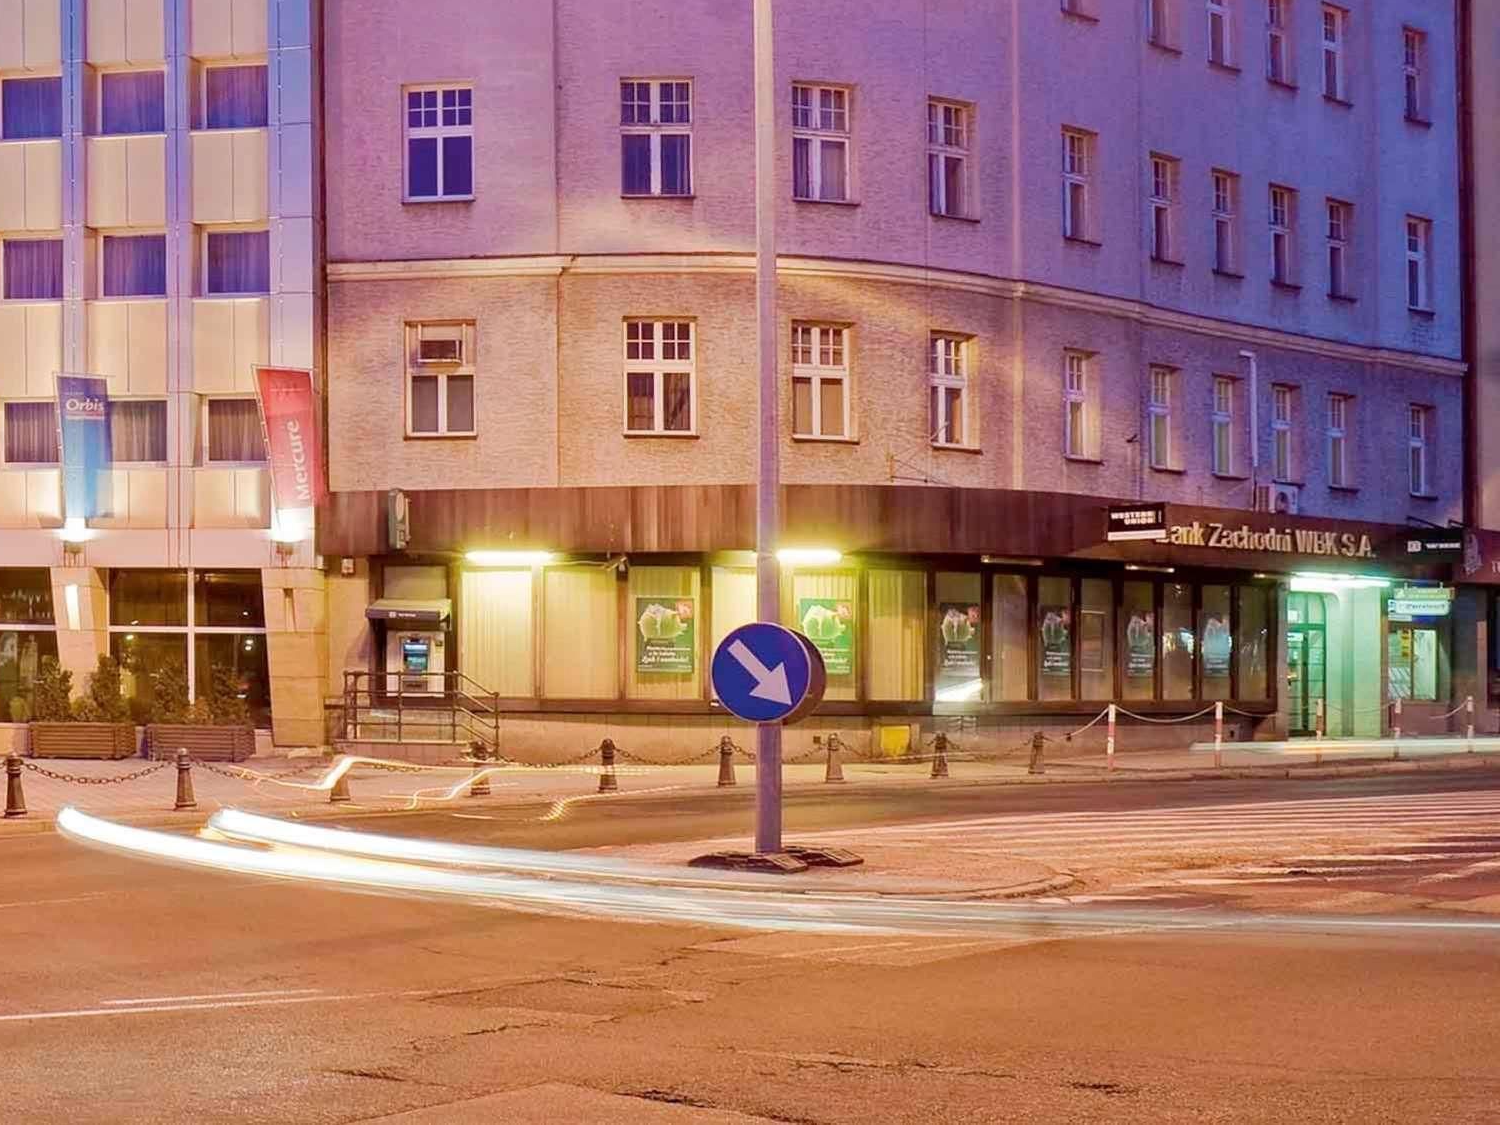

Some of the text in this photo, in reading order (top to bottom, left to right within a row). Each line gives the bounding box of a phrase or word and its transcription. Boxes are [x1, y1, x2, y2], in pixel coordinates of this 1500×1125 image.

[66, 398, 105, 411] Orbis
[1110, 510, 1156, 520] WESTERN
[1123, 518, 1156, 526] UNION
[1156, 521, 1205, 546] ank
[1208, 523, 1292, 552] Zachodni
[1295, 529, 1340, 555] WBK
